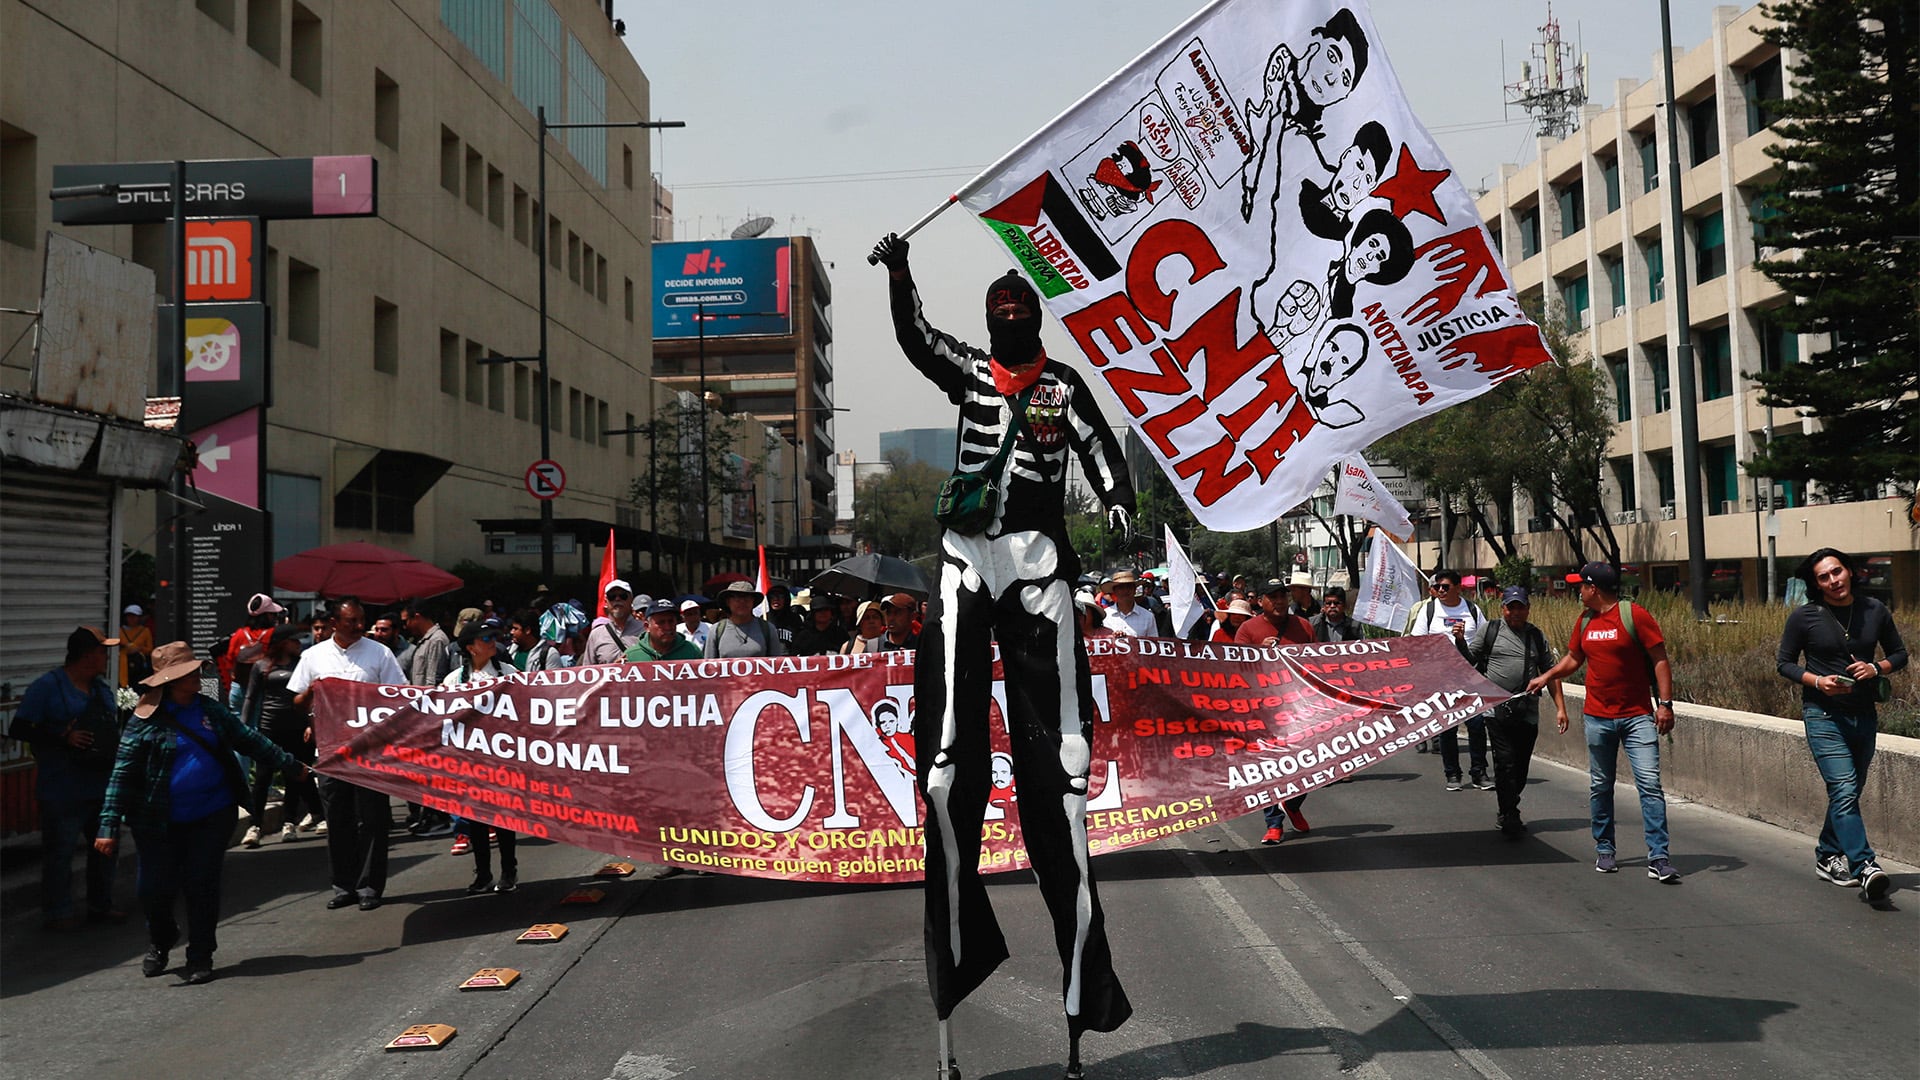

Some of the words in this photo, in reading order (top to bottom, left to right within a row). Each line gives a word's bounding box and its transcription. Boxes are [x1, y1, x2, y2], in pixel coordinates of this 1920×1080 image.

[1142, 113, 1173, 158] BASTA!
[1160, 118, 1172, 137] YA
[338, 173, 346, 197] 1
[1027, 223, 1090, 290] LIBERTAD
[664, 279, 694, 288] DECIDE
[695, 277, 744, 287] INFORMADO
[1417, 305, 1510, 352] JUSTICIA
[1360, 302, 1435, 406] AYOTZINAPA
[1061, 290, 1255, 508] EZLN
[652, 655, 819, 680] NACIONAL
[827, 652, 873, 672] DE
[1138, 638, 1177, 659] DE
[1183, 641, 1218, 662] LA
[1222, 639, 1391, 664] EDUCACIÓN
[1180, 670, 1250, 690] UMA
[1256, 668, 1294, 688] NI
[1301, 657, 1412, 677] AFORE
[530, 697, 578, 727] DE
[599, 693, 724, 729] LUCHA
[1191, 684, 1321, 715] Regreso
[440, 718, 631, 774] NACIONAL
[1134, 718, 1266, 738] Sistema
[382, 743, 527, 791] ABROGACIÓN
[530, 780, 549, 794] DE
[553, 784, 573, 800] LA
[1173, 742, 1214, 760] de
[1226, 715, 1396, 791] ABROGACIÓN
[1244, 793, 1270, 809] DE
[1276, 780, 1300, 800] LA
[1302, 765, 1336, 790] LEY
[1339, 752, 1377, 775] DEL
[1377, 718, 1443, 757] ISSSTE
[430, 773, 527, 814] REFORMA
[530, 801, 640, 834] EDUCATIVA
[493, 812, 549, 839] AMLO
[659, 826, 777, 850] ¡UNIDOS
[781, 831, 800, 850] Y
[662, 847, 767, 872] ¡Gobierne
[773, 856, 832, 874] quien
[1105, 811, 1218, 848] defienden!
